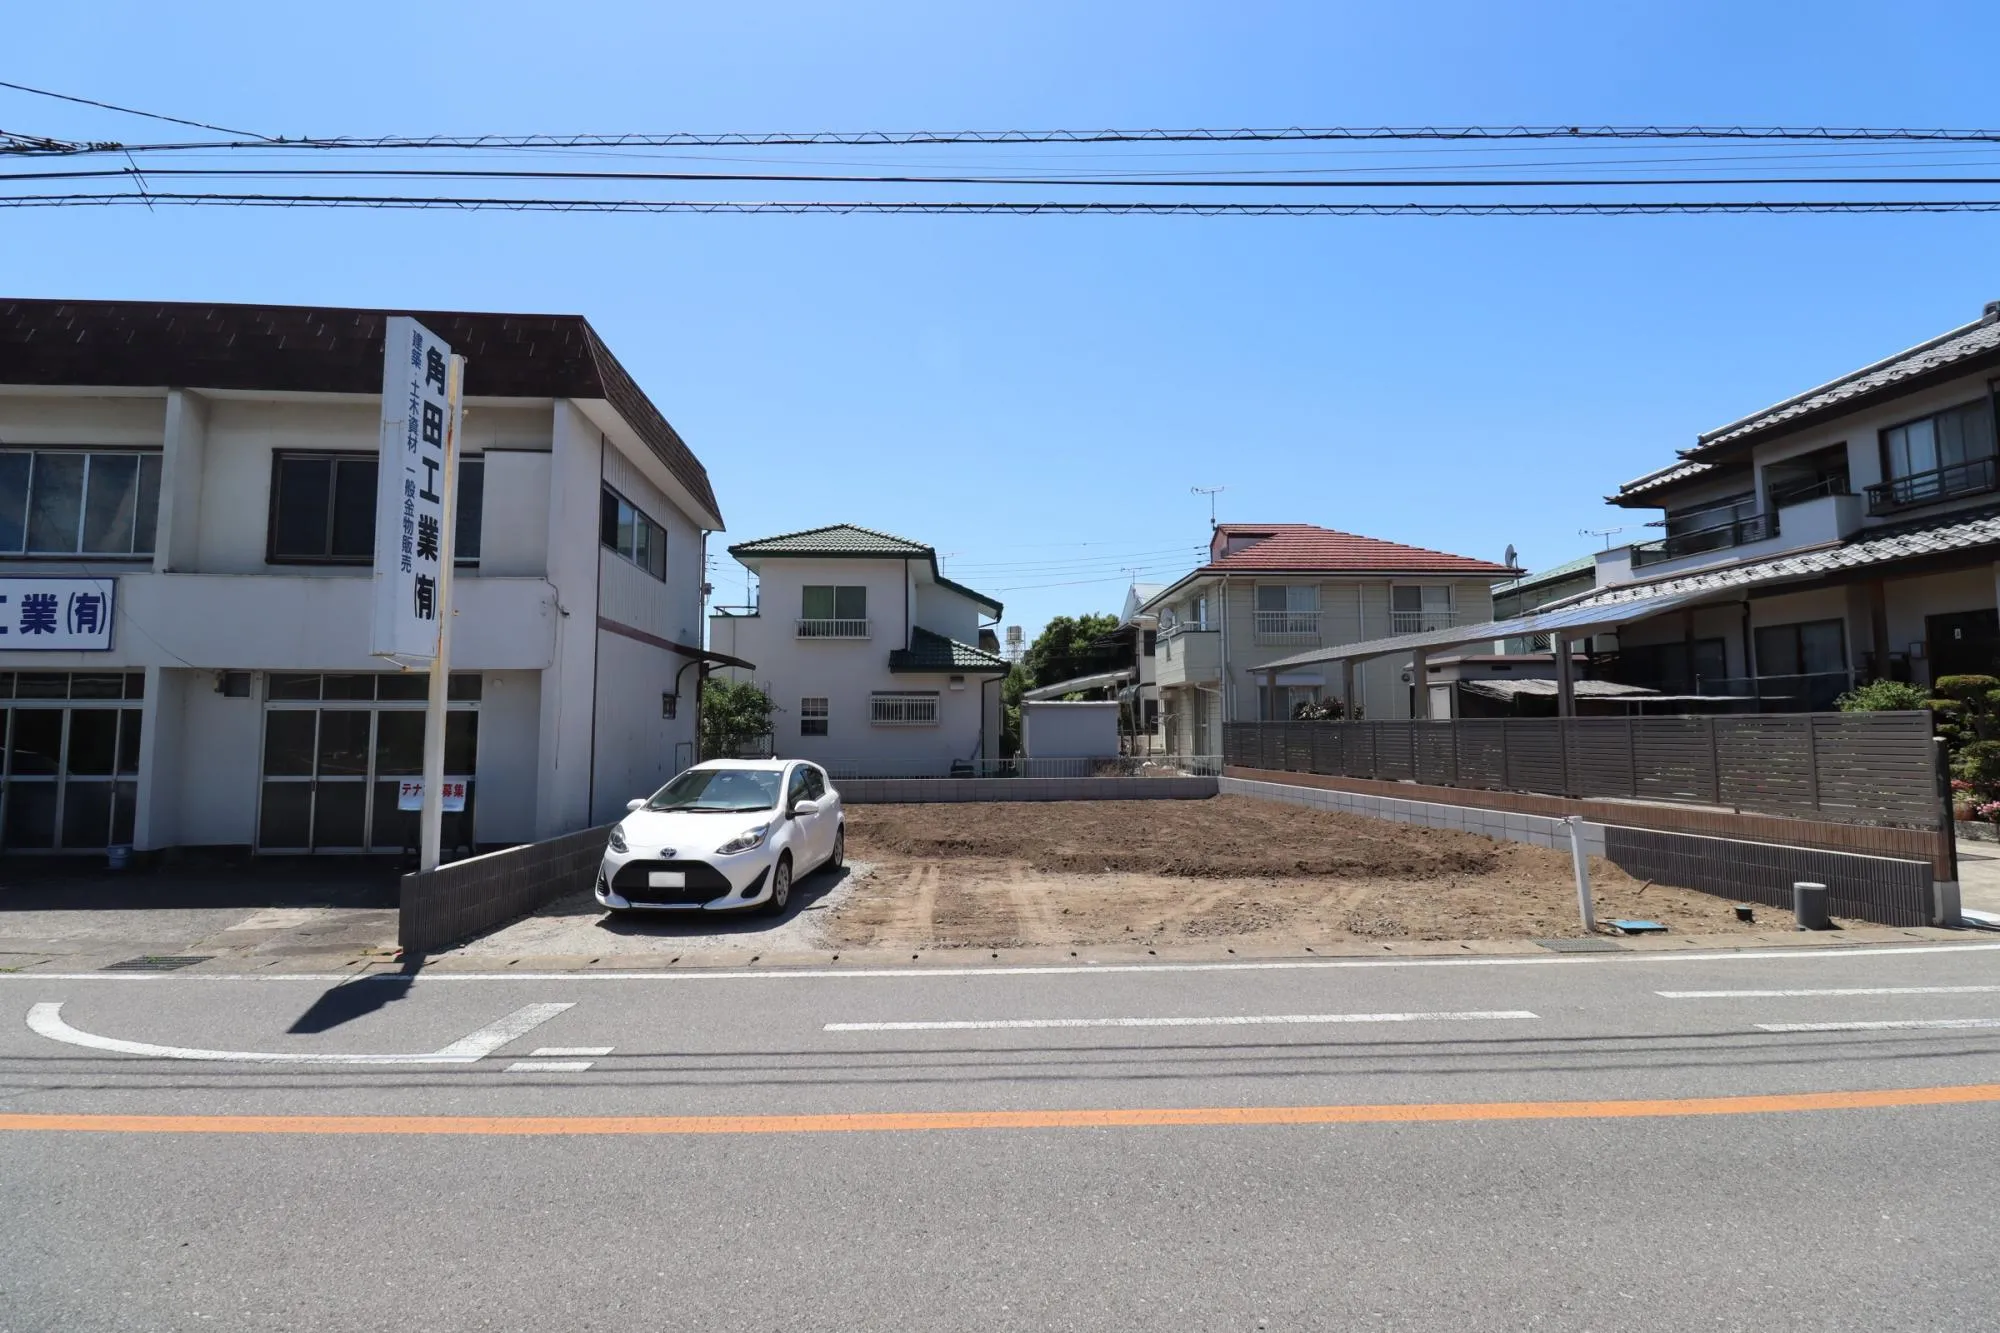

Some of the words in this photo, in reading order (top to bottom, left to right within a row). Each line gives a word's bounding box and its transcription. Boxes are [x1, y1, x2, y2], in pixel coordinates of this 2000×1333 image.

[400, 466, 416, 574] 一般金物販売
[0, 592, 106, 635] 業(有)
[402, 783, 464, 798] テナ募集
